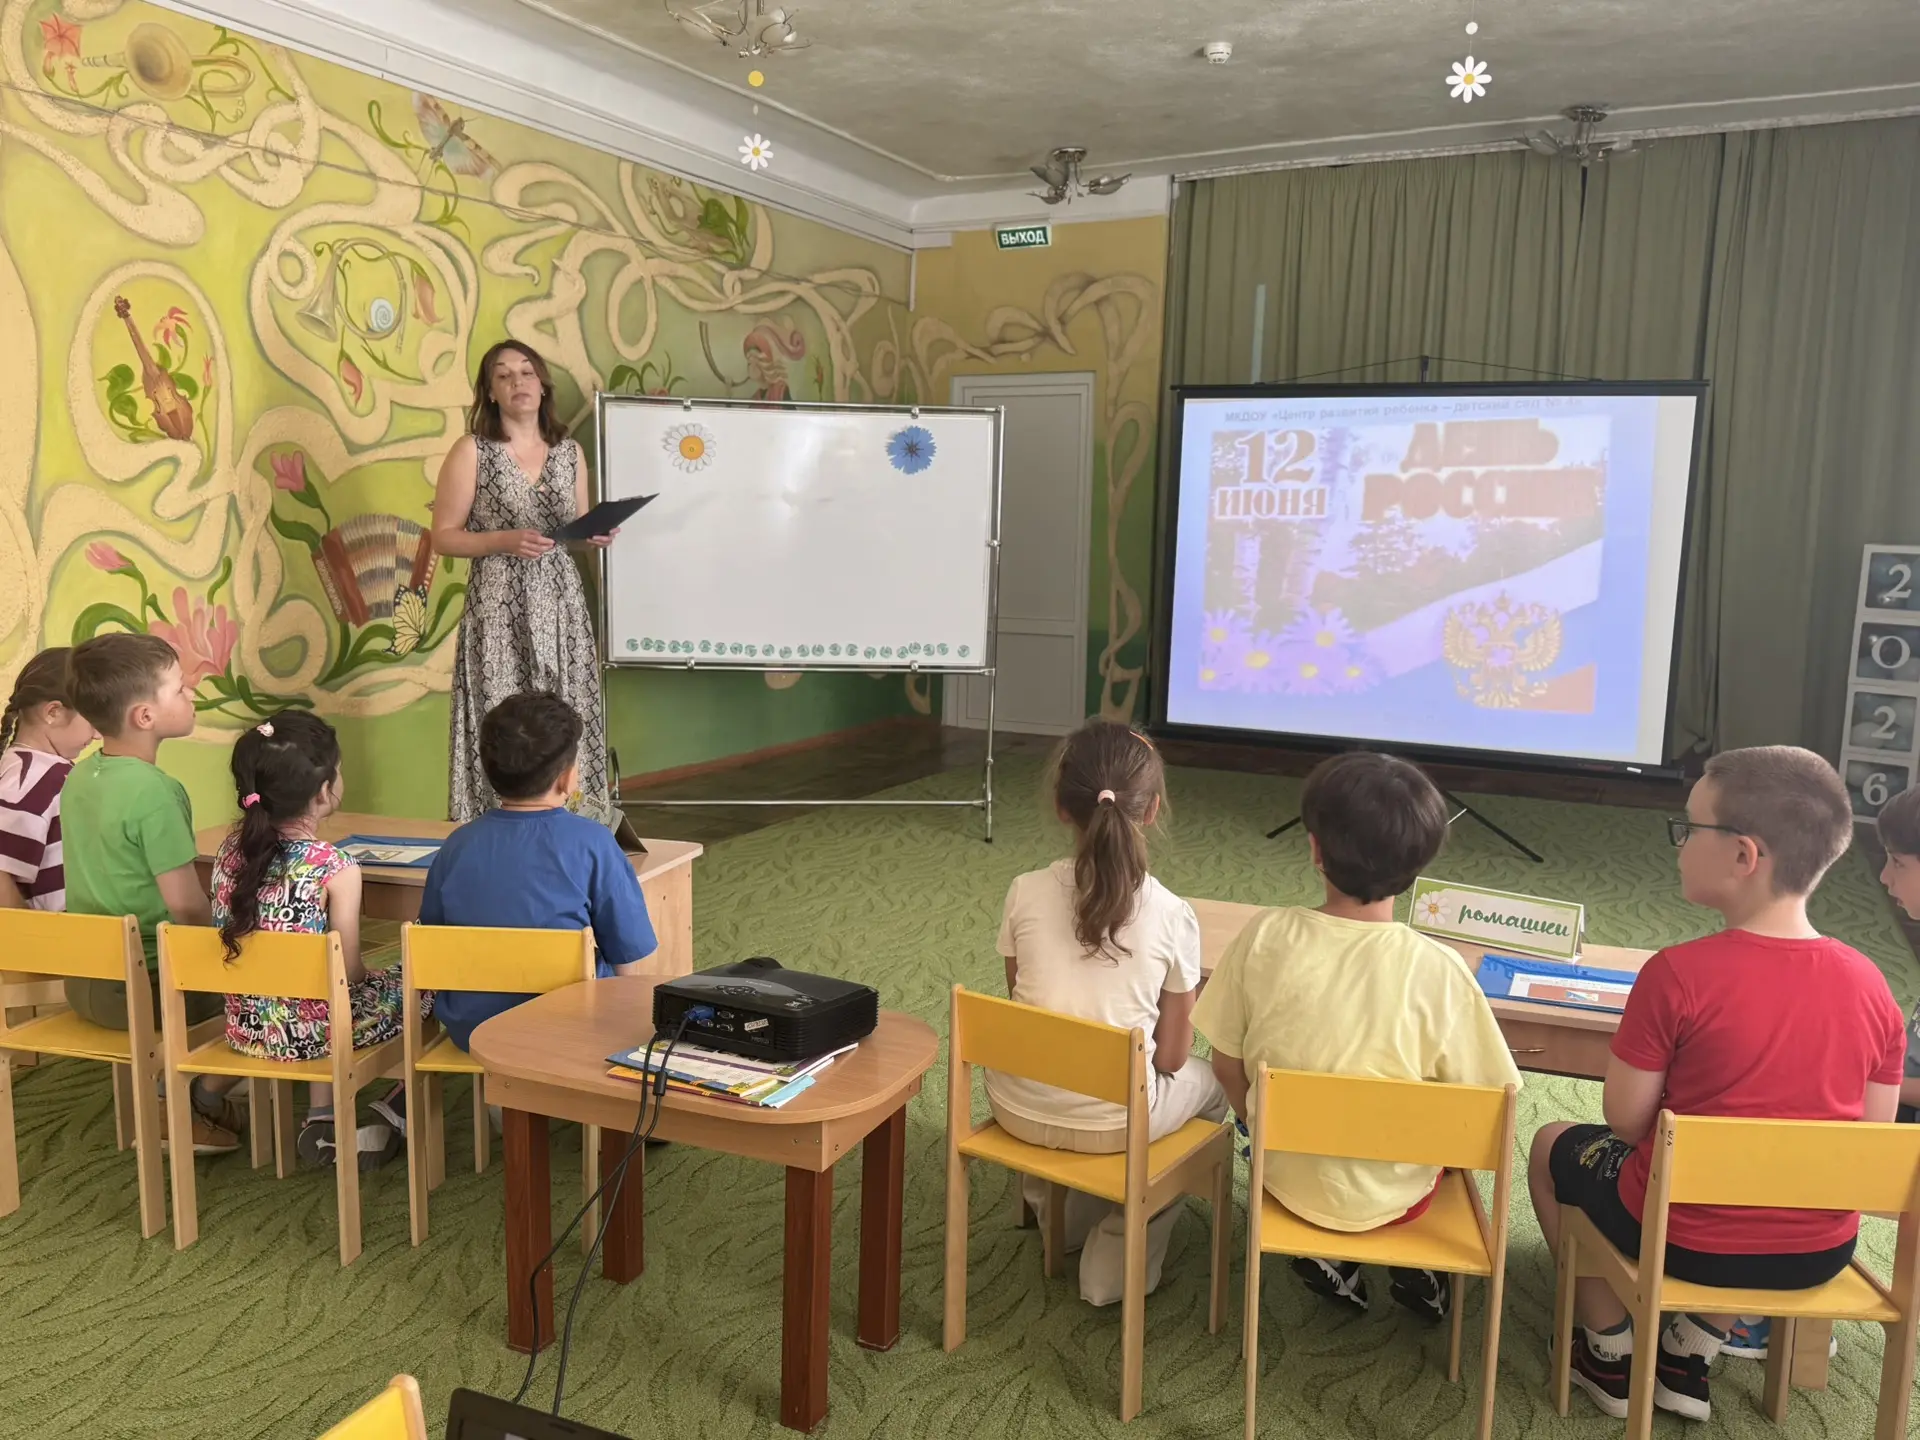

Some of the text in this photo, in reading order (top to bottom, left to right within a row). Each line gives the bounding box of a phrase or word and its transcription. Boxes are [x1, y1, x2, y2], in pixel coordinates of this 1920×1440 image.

[1001, 230, 1046, 245] ВЫХОД
[1224, 410, 1267, 423] МКДОУ
[1235, 429, 1317, 485] 12
[1361, 470, 1598, 521] РОСС
[1458, 904, 1570, 936] ромашки
